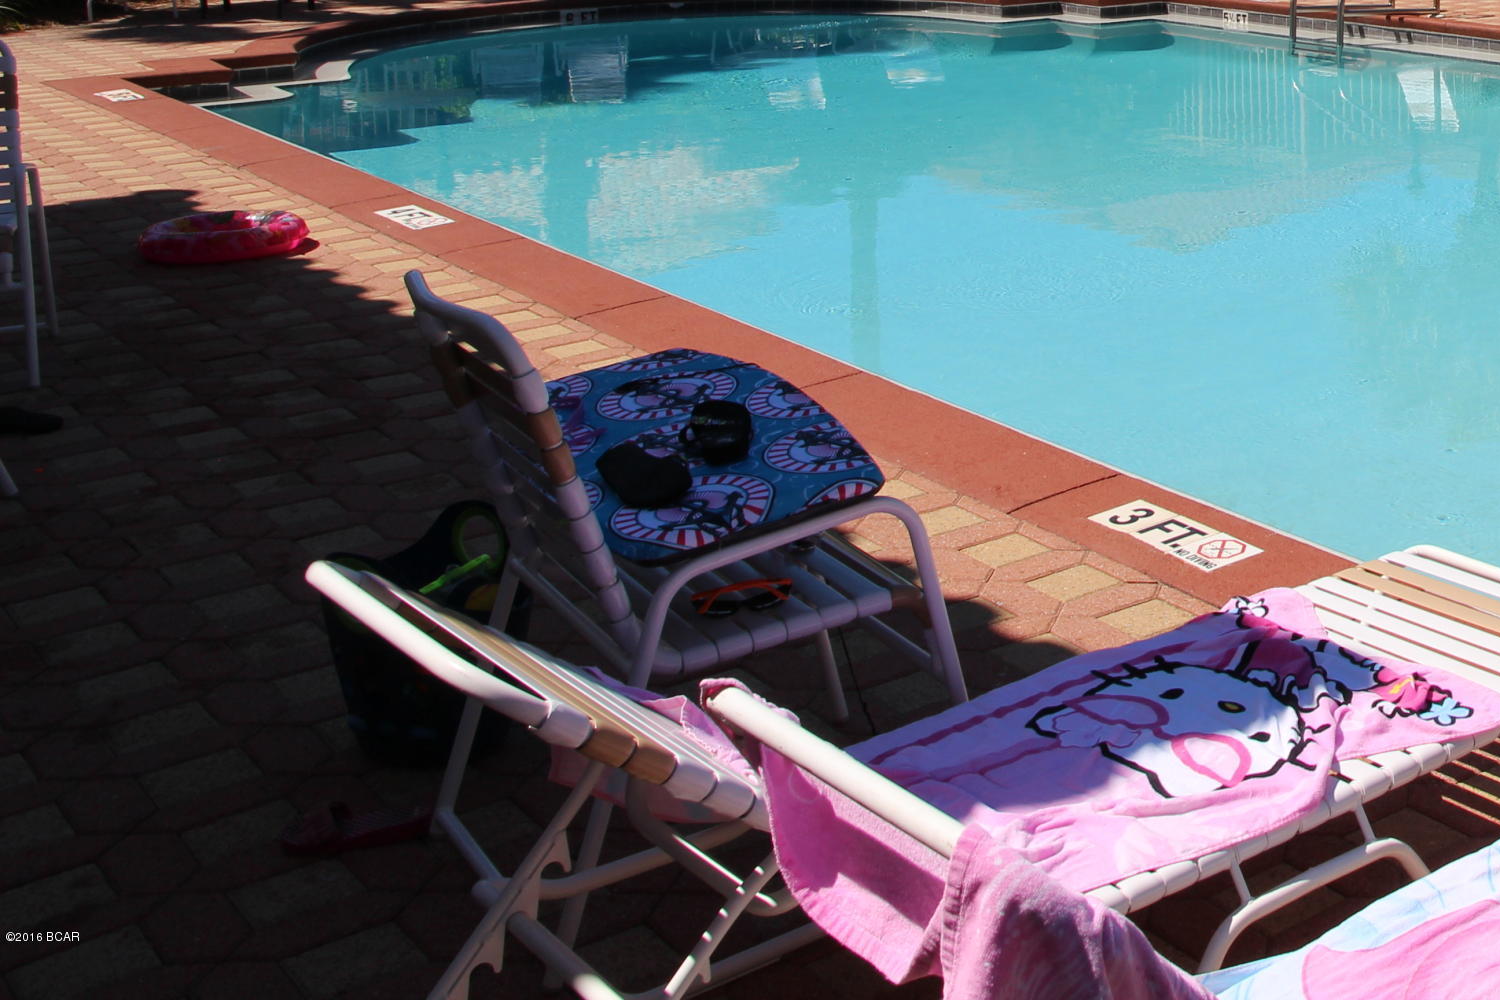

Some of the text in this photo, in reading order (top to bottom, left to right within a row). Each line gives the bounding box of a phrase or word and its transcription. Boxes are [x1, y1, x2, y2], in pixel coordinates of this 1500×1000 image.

[1108, 508, 1155, 525] 3
[1173, 548, 1218, 570] NO DIVING
